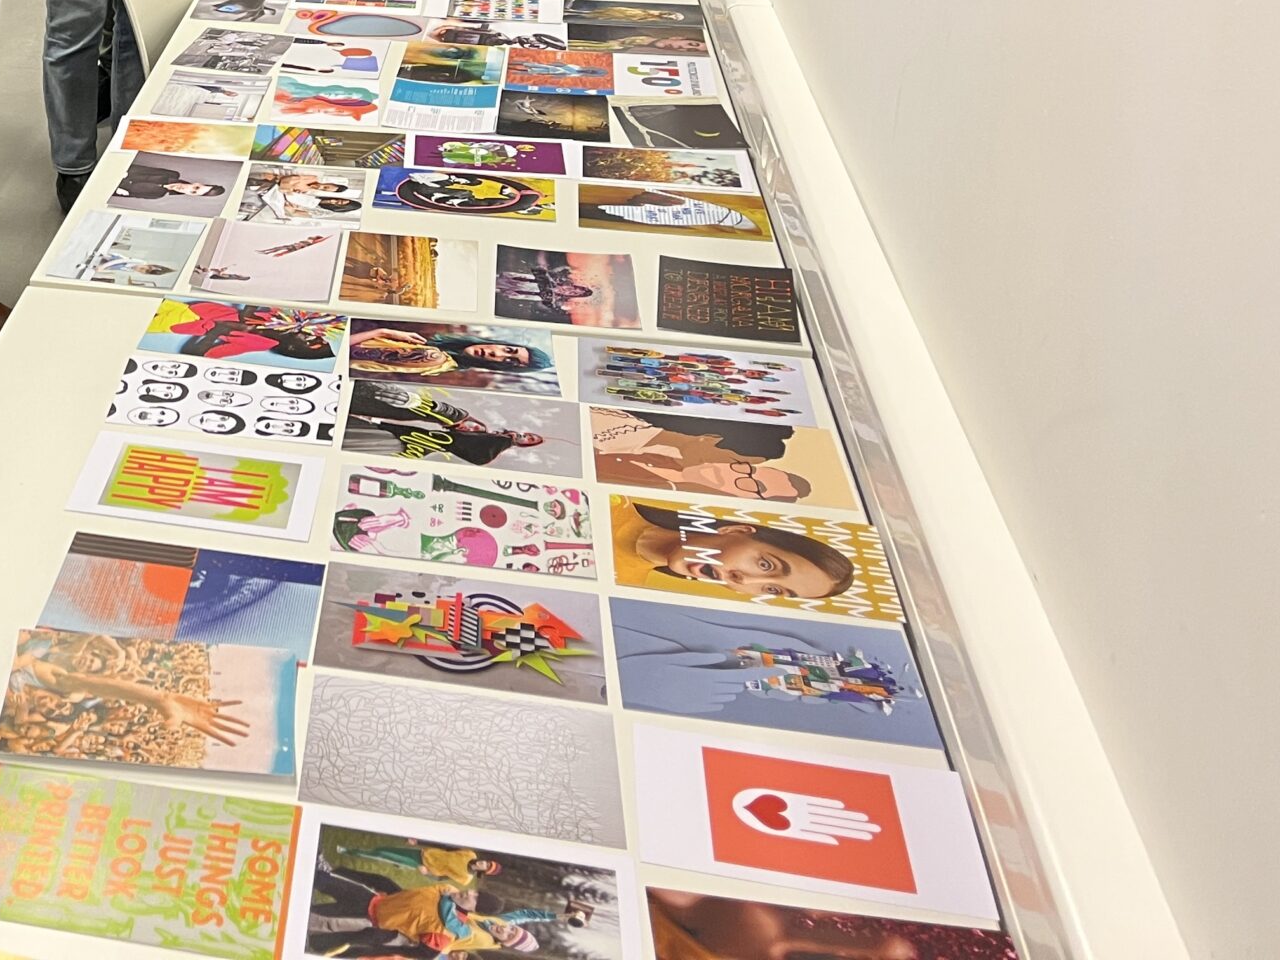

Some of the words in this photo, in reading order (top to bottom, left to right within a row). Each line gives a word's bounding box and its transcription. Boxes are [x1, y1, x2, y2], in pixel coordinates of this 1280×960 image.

[111, 449, 199, 510] HAPPY
[188, 475, 266, 510] AM
[199, 466, 269, 479] I
[56, 804, 111, 901] BETTER
[102, 818, 152, 899] LOOK
[152, 832, 193, 897] JUST
[191, 822, 241, 928] THINGS
[239, 838, 282, 923] SOME
